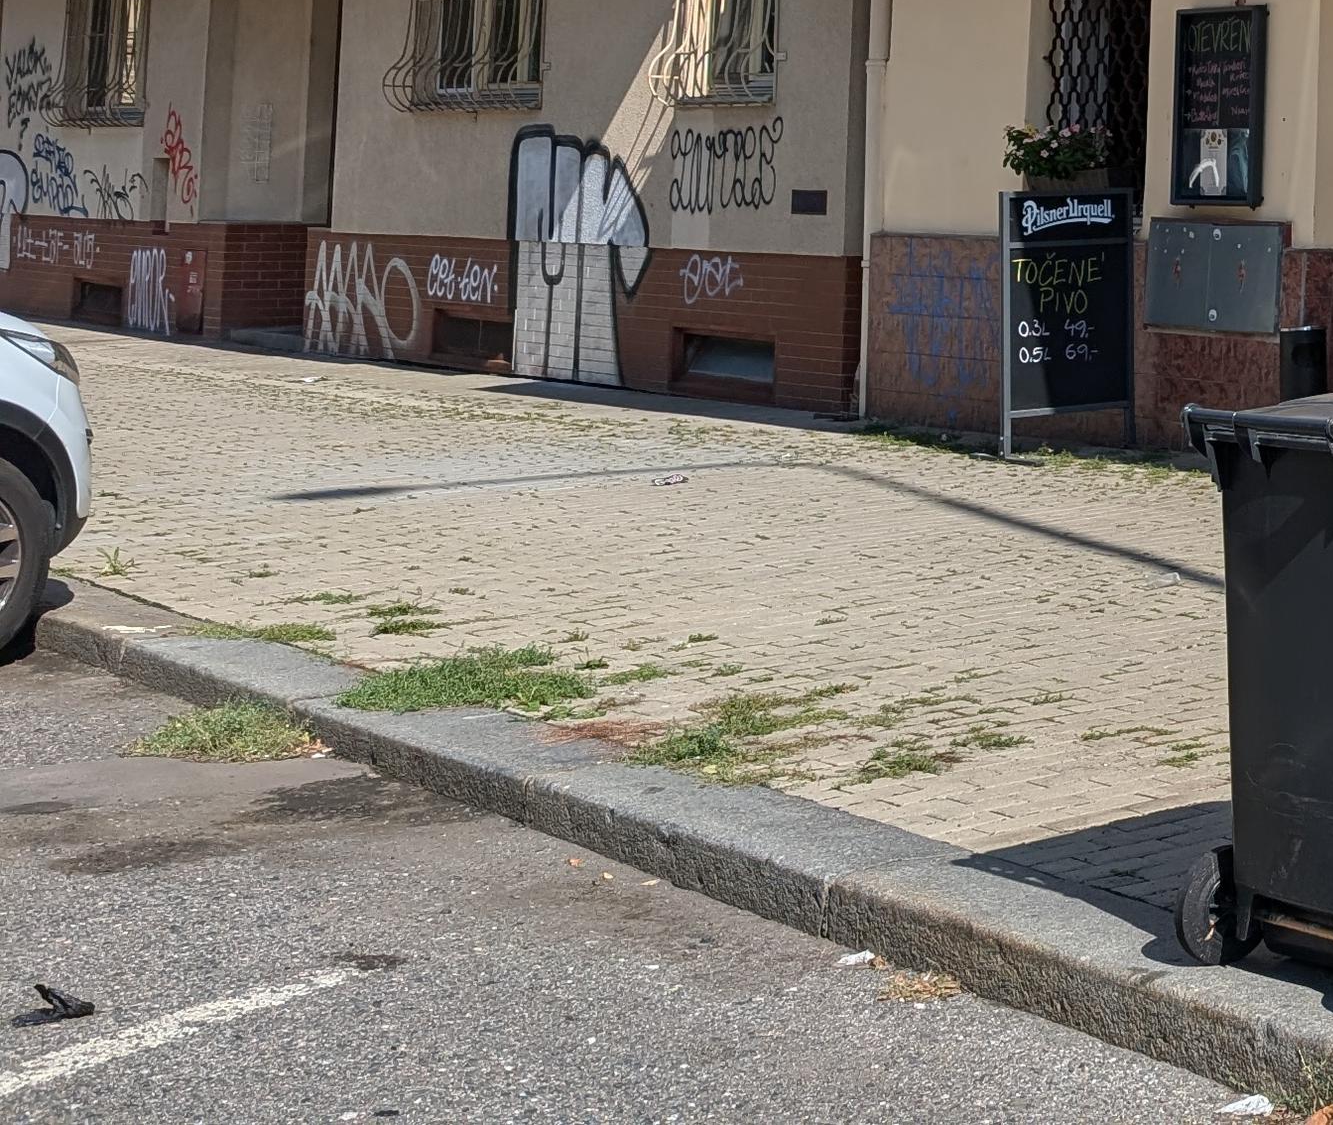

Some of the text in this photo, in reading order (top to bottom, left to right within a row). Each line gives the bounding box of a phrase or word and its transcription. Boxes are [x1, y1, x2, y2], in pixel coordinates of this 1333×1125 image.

[1022, 197, 1112, 236] Pilsner Urquell
[1012, 252, 1105, 287] TOČENÉ
[1040, 287, 1088, 315] PIVO
